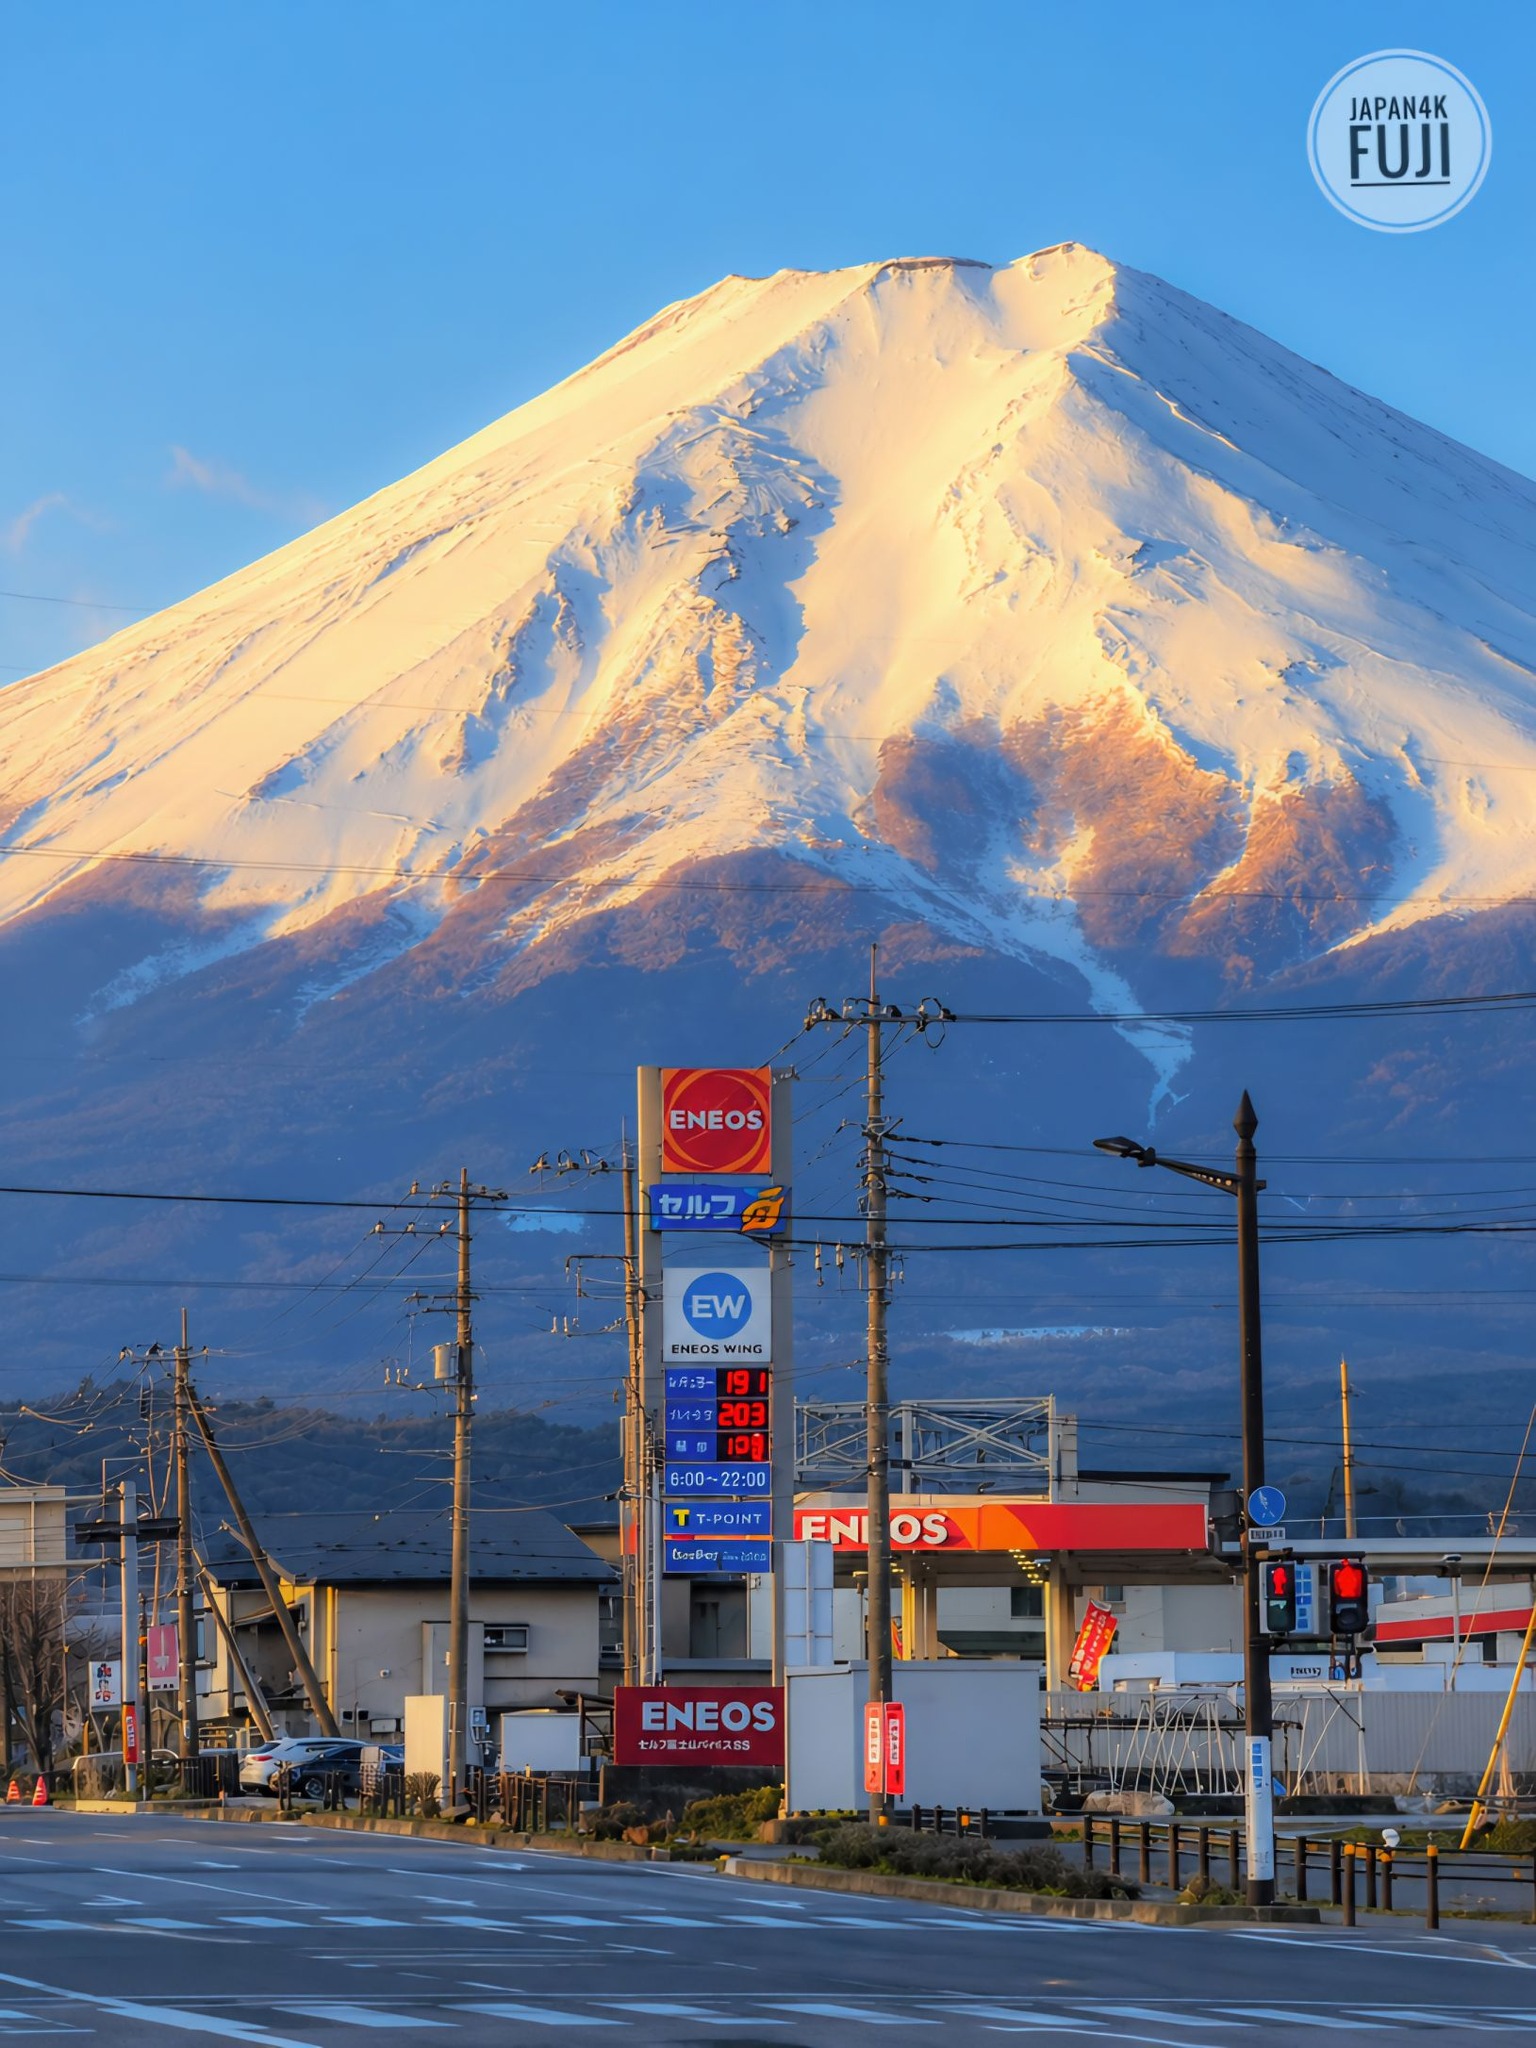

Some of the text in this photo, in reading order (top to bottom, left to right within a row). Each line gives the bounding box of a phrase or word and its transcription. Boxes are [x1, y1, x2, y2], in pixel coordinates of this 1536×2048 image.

[670, 1109, 763, 1130] ENEOS
[659, 1194, 736, 1220] セルフ
[692, 1294, 746, 1319] EW
[671, 1344, 763, 1354] ENEOS WING
[726, 1370, 766, 1395] 191
[718, 1402, 765, 1427] 203
[673, 1509, 762, 1527] T T-POINT
[642, 1701, 776, 1731] ENEOS
